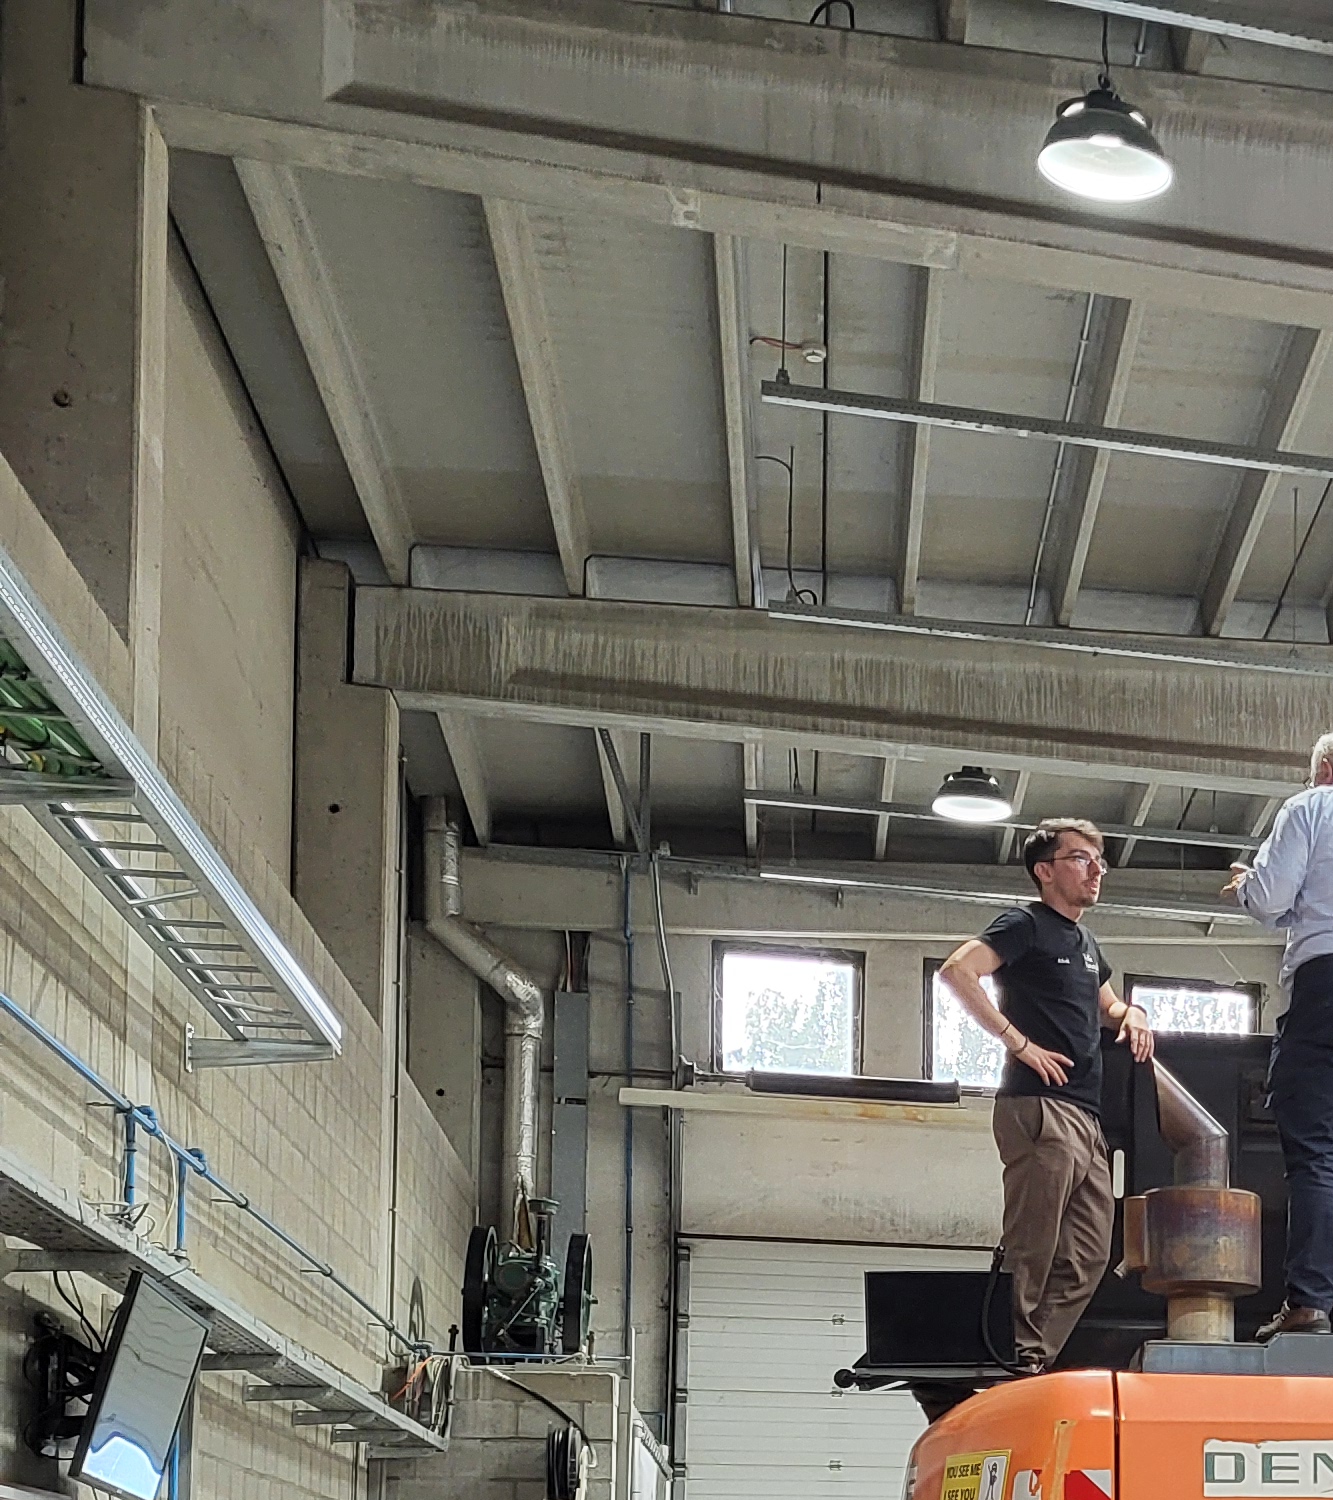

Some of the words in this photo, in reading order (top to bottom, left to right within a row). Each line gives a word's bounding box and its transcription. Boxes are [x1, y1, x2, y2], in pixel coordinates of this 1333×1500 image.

[946, 1466, 958, 1478] YOU
[958, 1464, 970, 1477] SEE
[970, 1463, 981, 1476] ME
